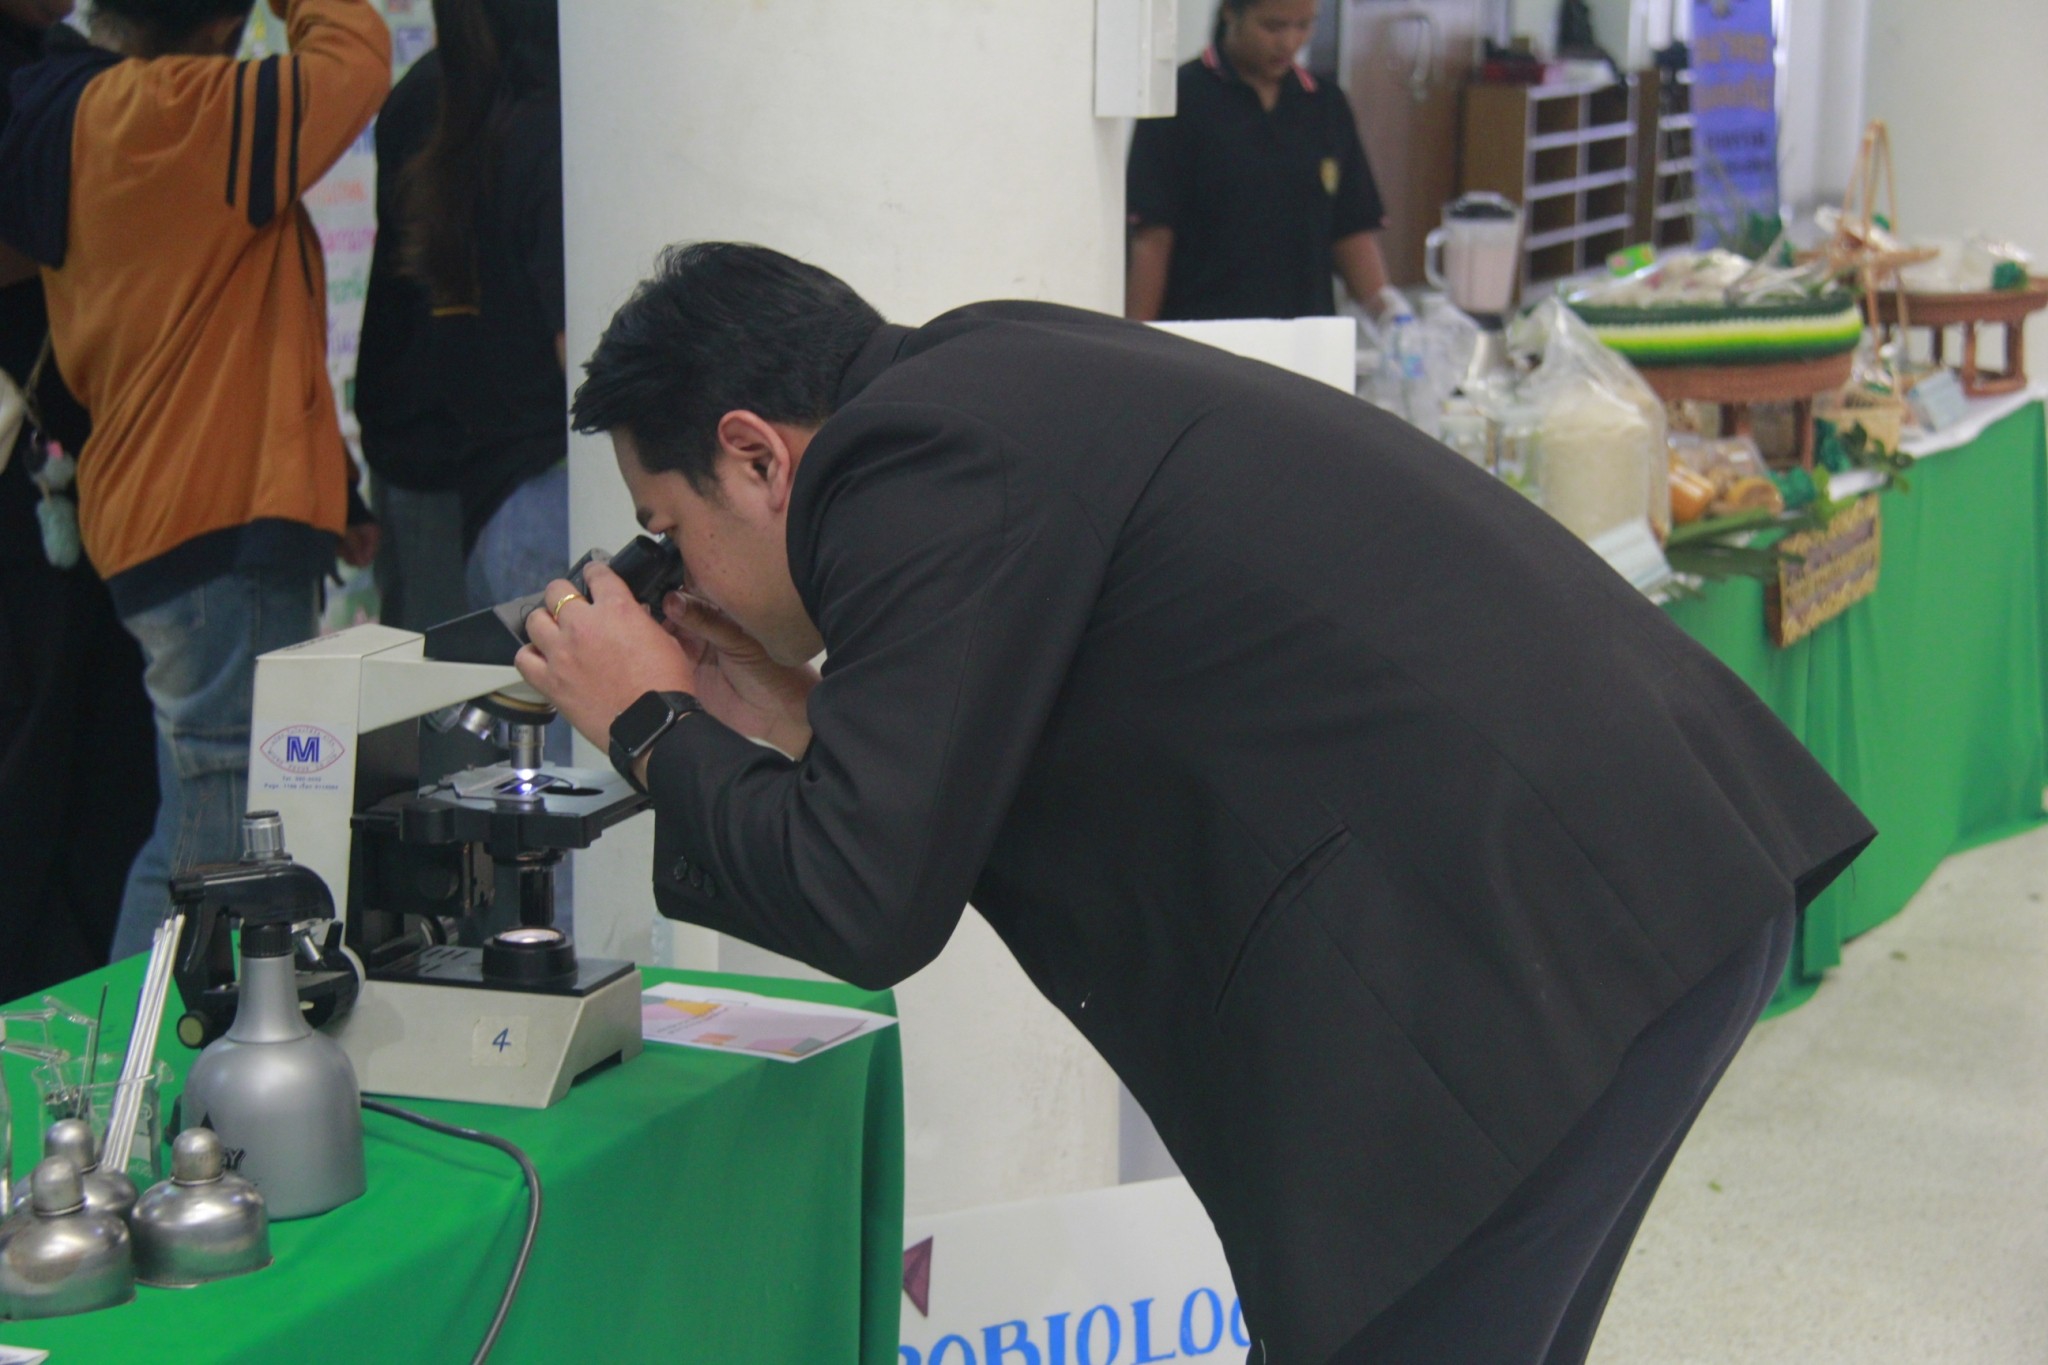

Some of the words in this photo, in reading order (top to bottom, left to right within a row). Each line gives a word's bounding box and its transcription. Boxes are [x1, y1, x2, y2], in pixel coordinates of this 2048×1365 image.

[286, 736, 320, 763] M
[492, 1027, 512, 1053] 4
[897, 1286, 1251, 1365] BIOLO
